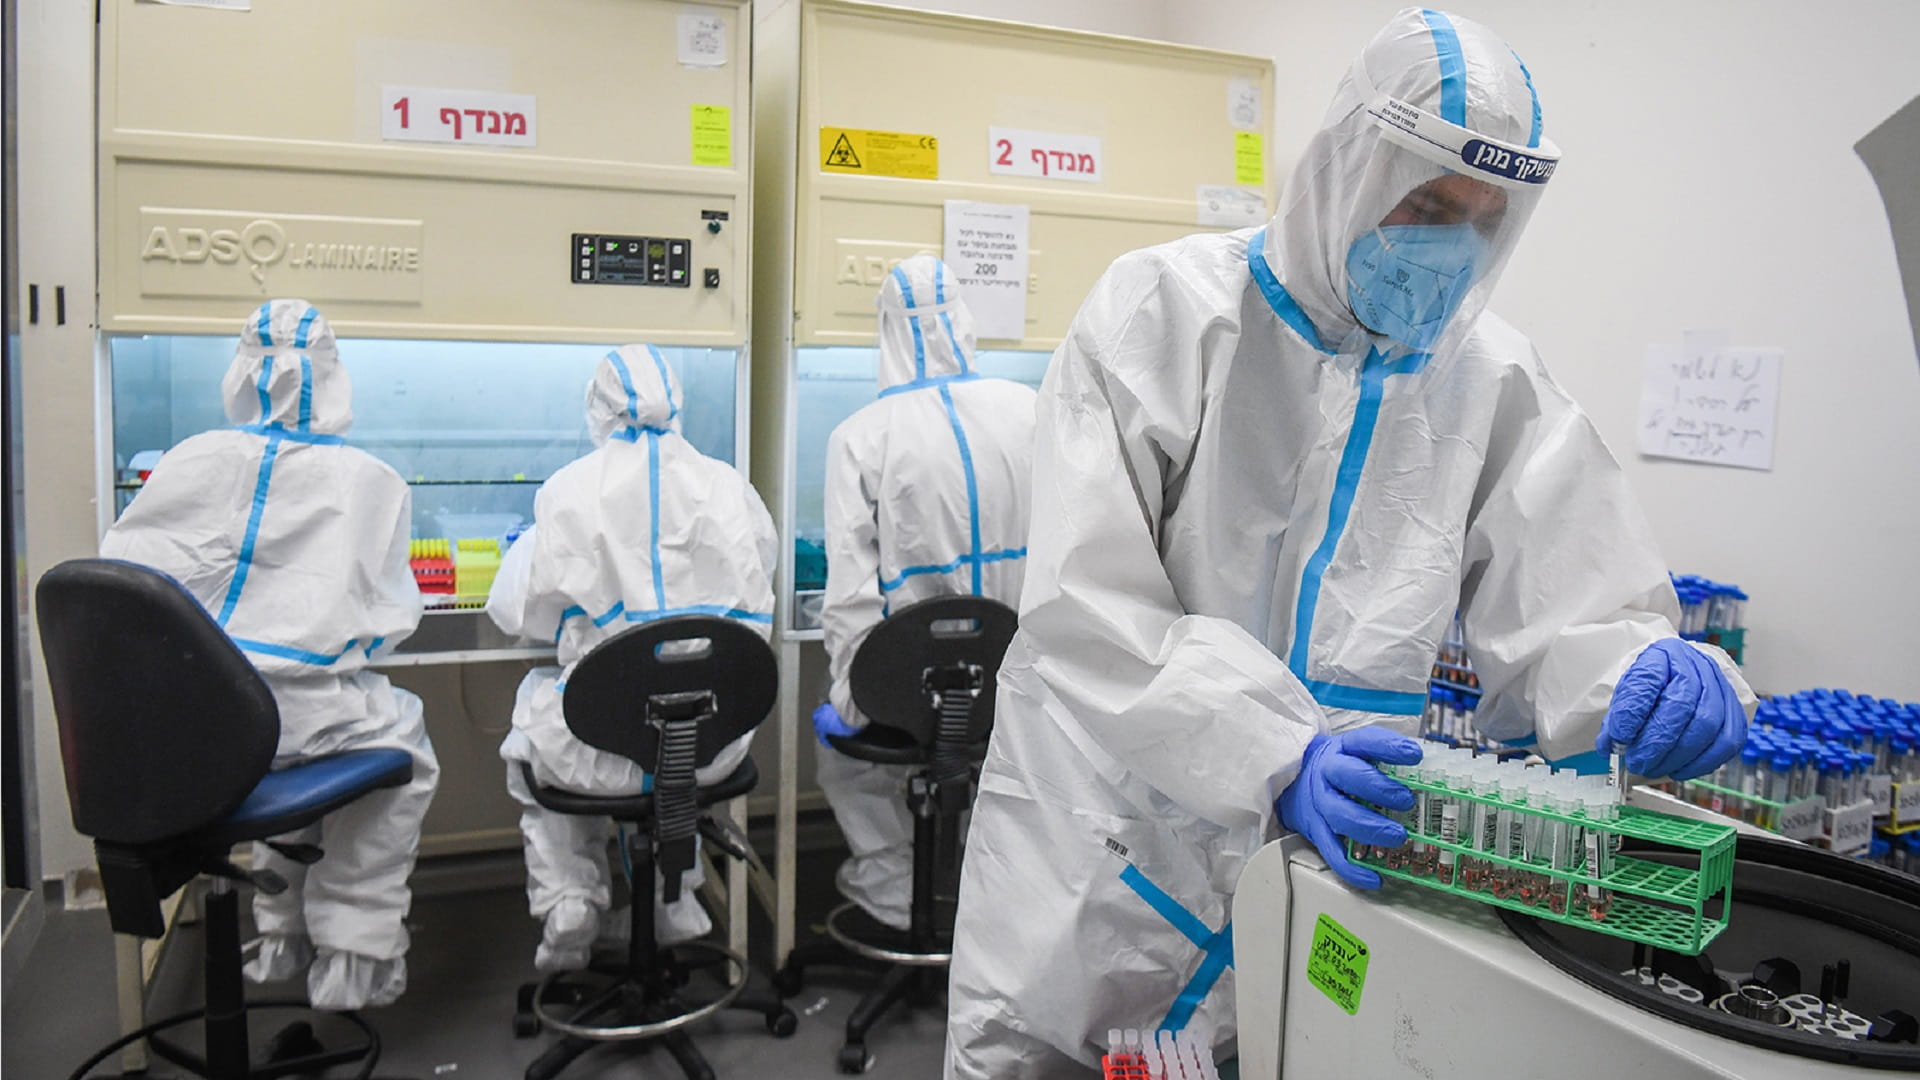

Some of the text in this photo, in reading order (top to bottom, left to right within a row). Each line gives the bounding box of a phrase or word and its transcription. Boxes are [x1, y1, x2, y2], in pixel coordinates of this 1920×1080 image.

[393, 97, 527, 140] מנדף 1
[996, 138, 1096, 176] מנדף 2
[1473, 144, 1555, 180] משקף מגן
[288, 242, 419, 272] LAMINAIRE
[975, 262, 998, 276] 200
